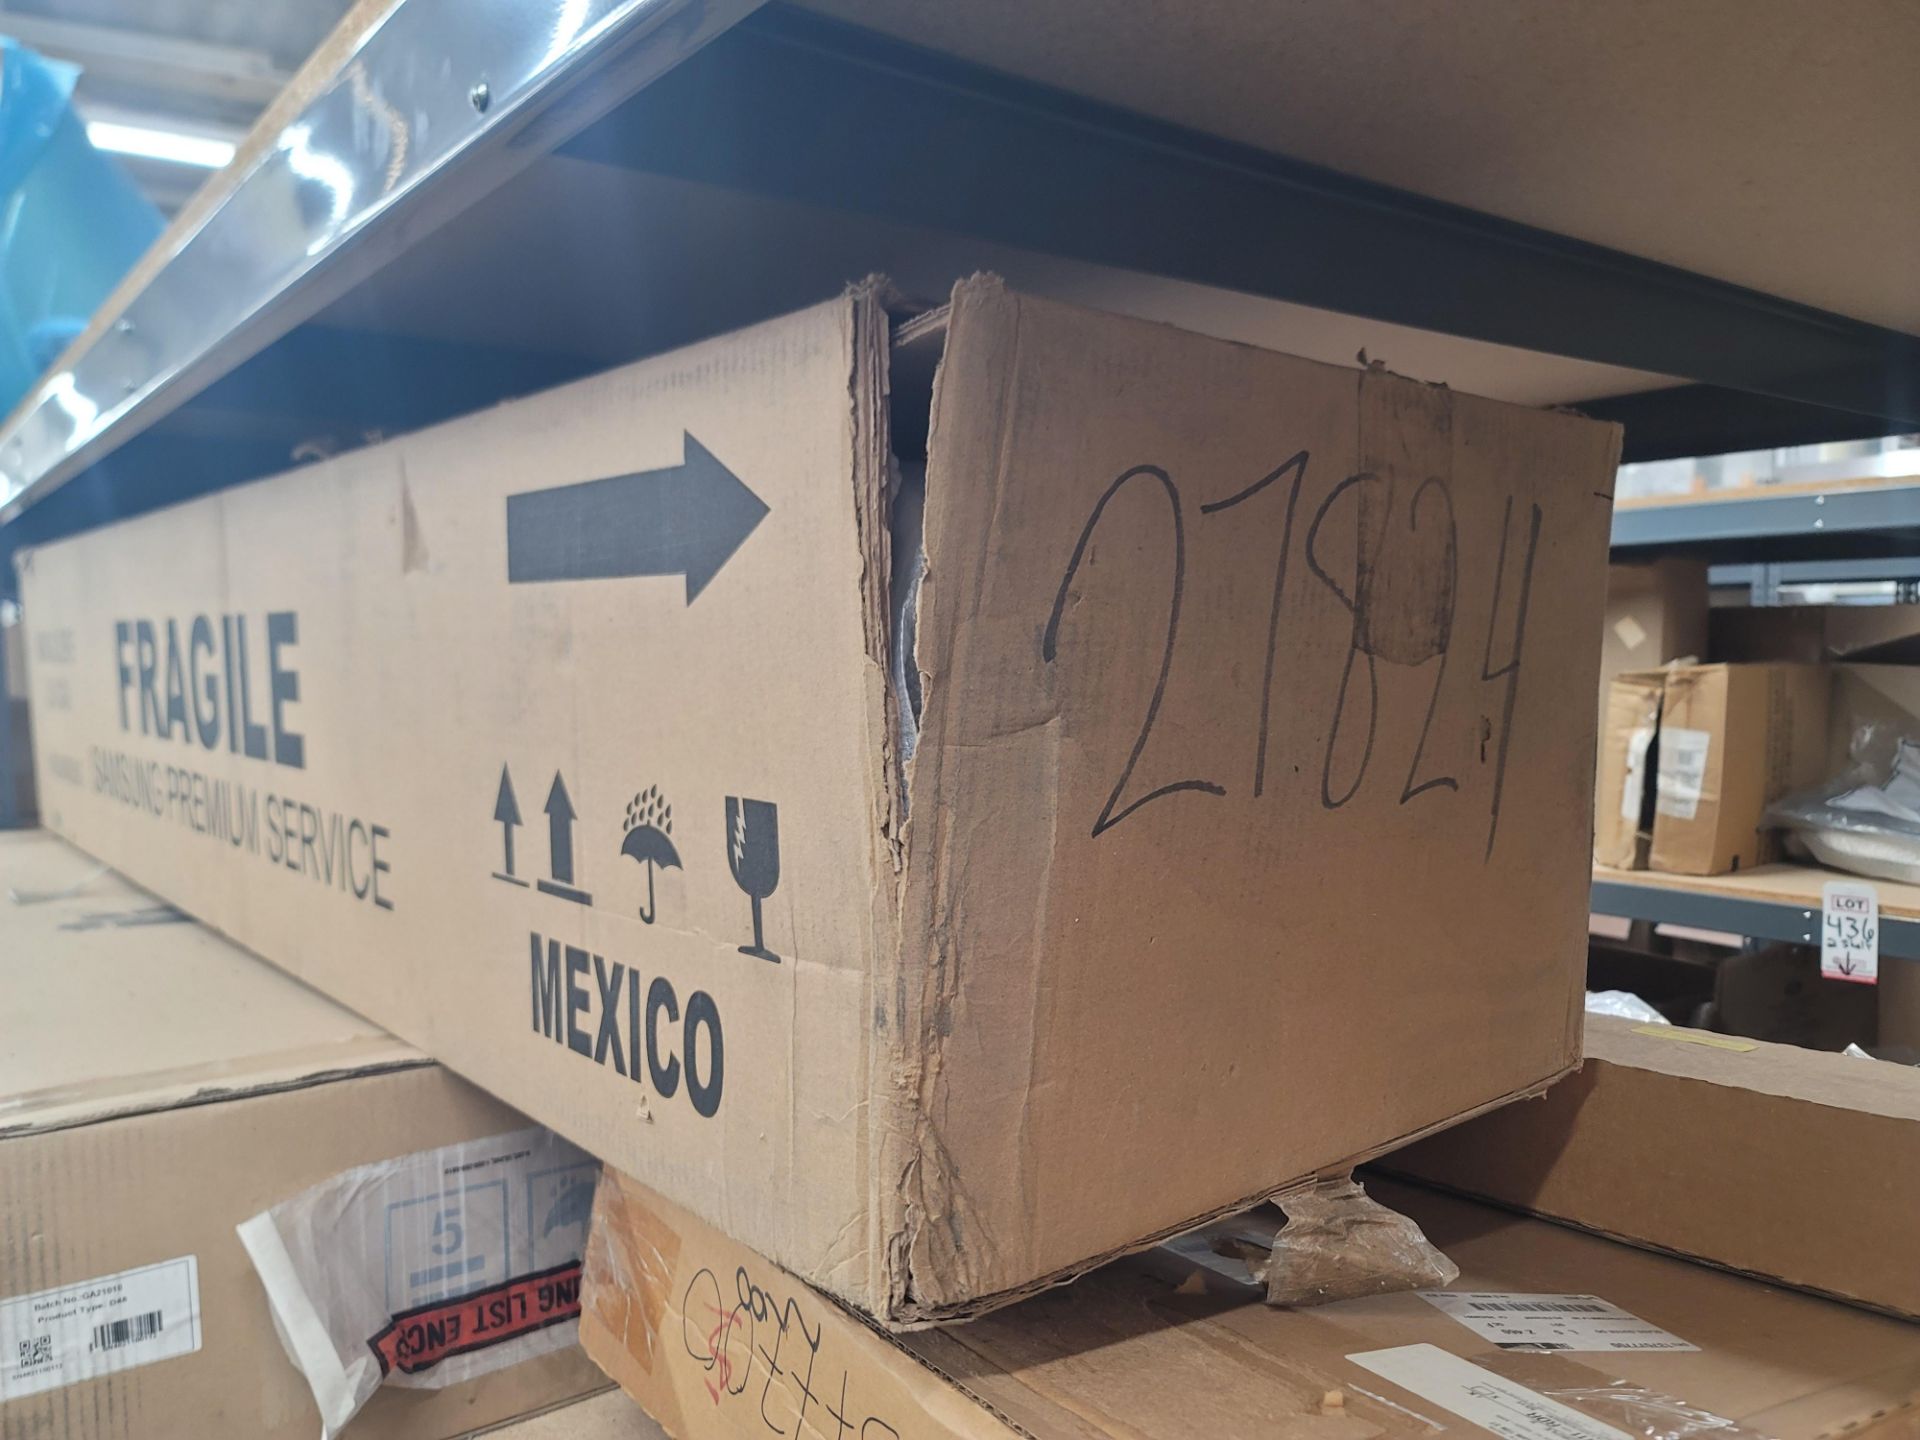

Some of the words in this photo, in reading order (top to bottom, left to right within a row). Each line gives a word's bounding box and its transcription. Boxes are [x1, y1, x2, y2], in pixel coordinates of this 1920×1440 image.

[114, 611, 305, 769] FRAGILE
[1042, 450, 1542, 865] 27824
[92, 746, 164, 818] SAMSUNG
[165, 763, 260, 856] PREMIUM
[266, 793, 394, 912] SERVICE
[1836, 898, 1865, 909] LOT
[1826, 914, 1875, 942] 436
[530, 930, 724, 1118] MEXICO
[473, 1292, 527, 1334] LIST
